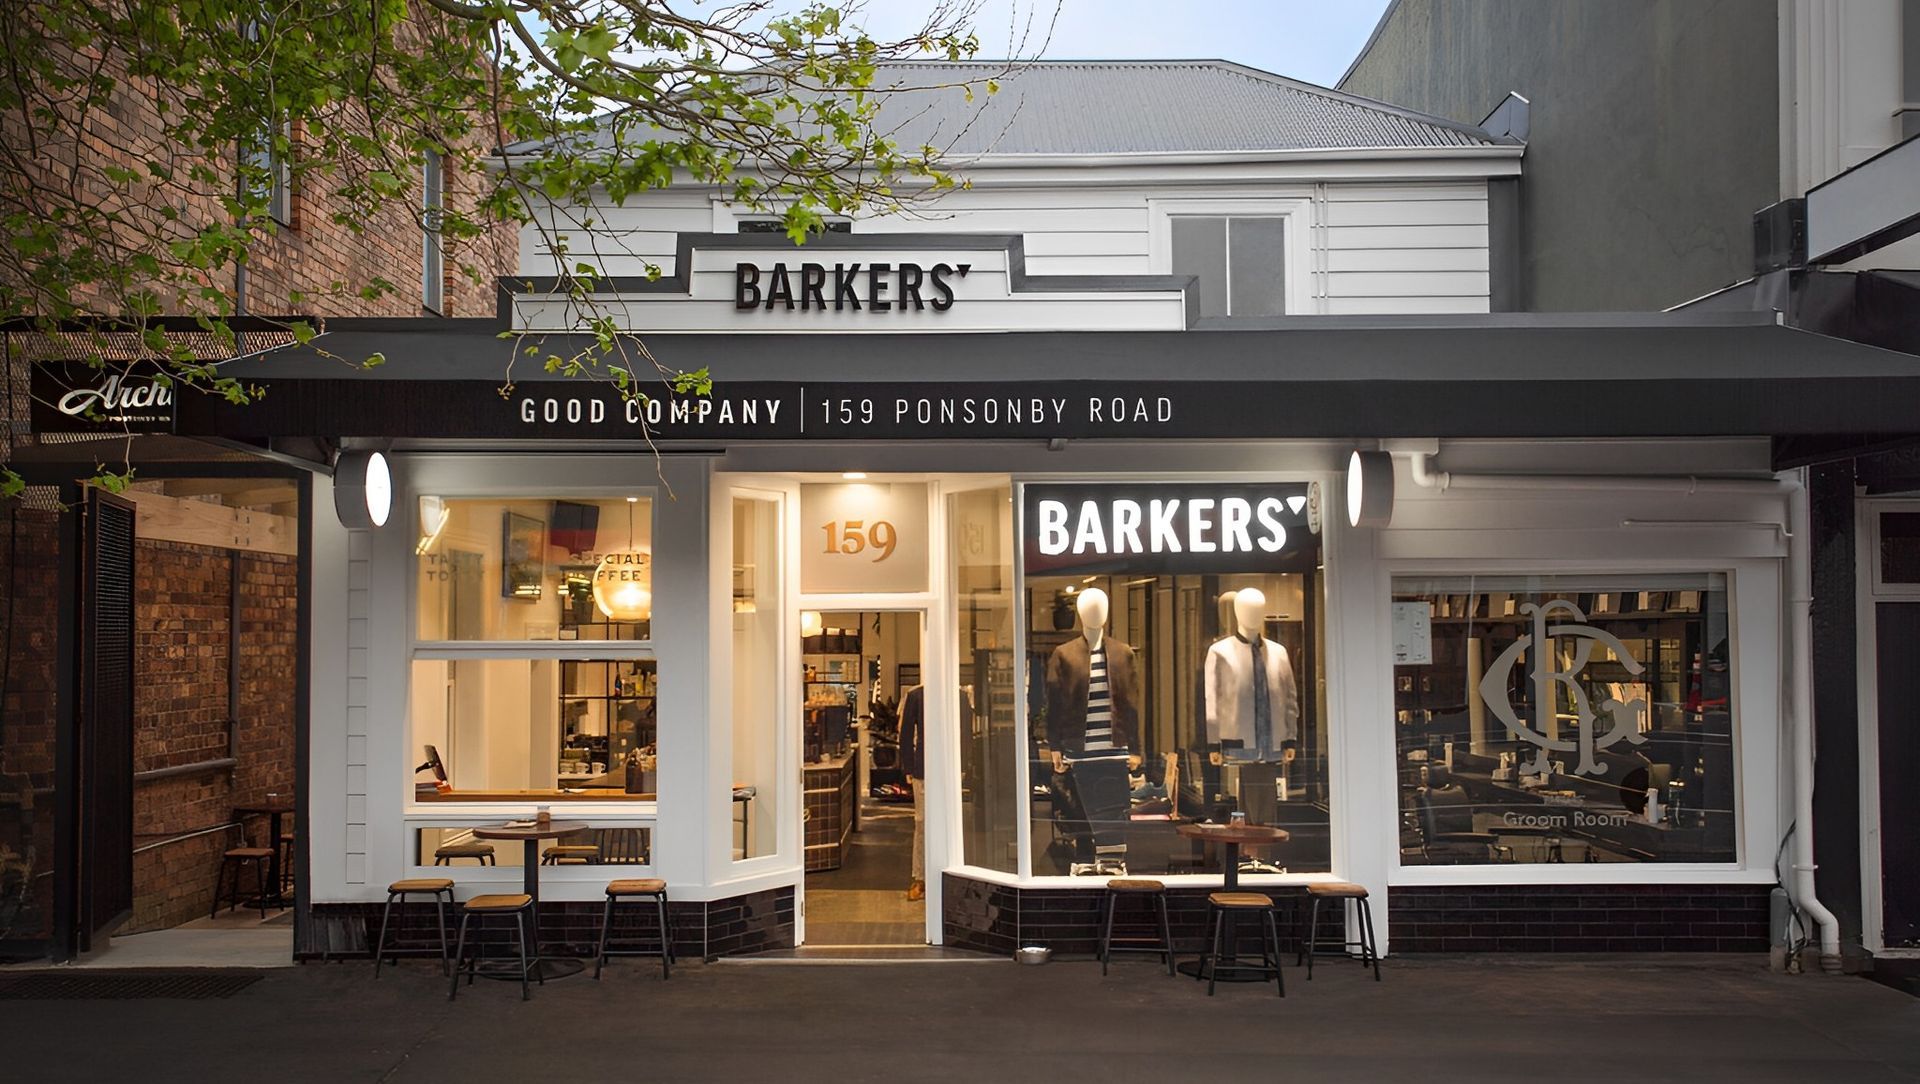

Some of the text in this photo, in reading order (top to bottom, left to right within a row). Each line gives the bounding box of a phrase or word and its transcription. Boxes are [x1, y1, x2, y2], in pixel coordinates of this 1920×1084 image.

[736, 263, 955, 311] BARKERS
[58, 374, 172, 416] Arch
[521, 397, 1174, 424] GOOD COMPANY 159 PONSONBY ROAD
[822, 520, 897, 563] 159
[1039, 496, 1287, 556] BARKERS
[1502, 811, 1628, 827] Groom Room
